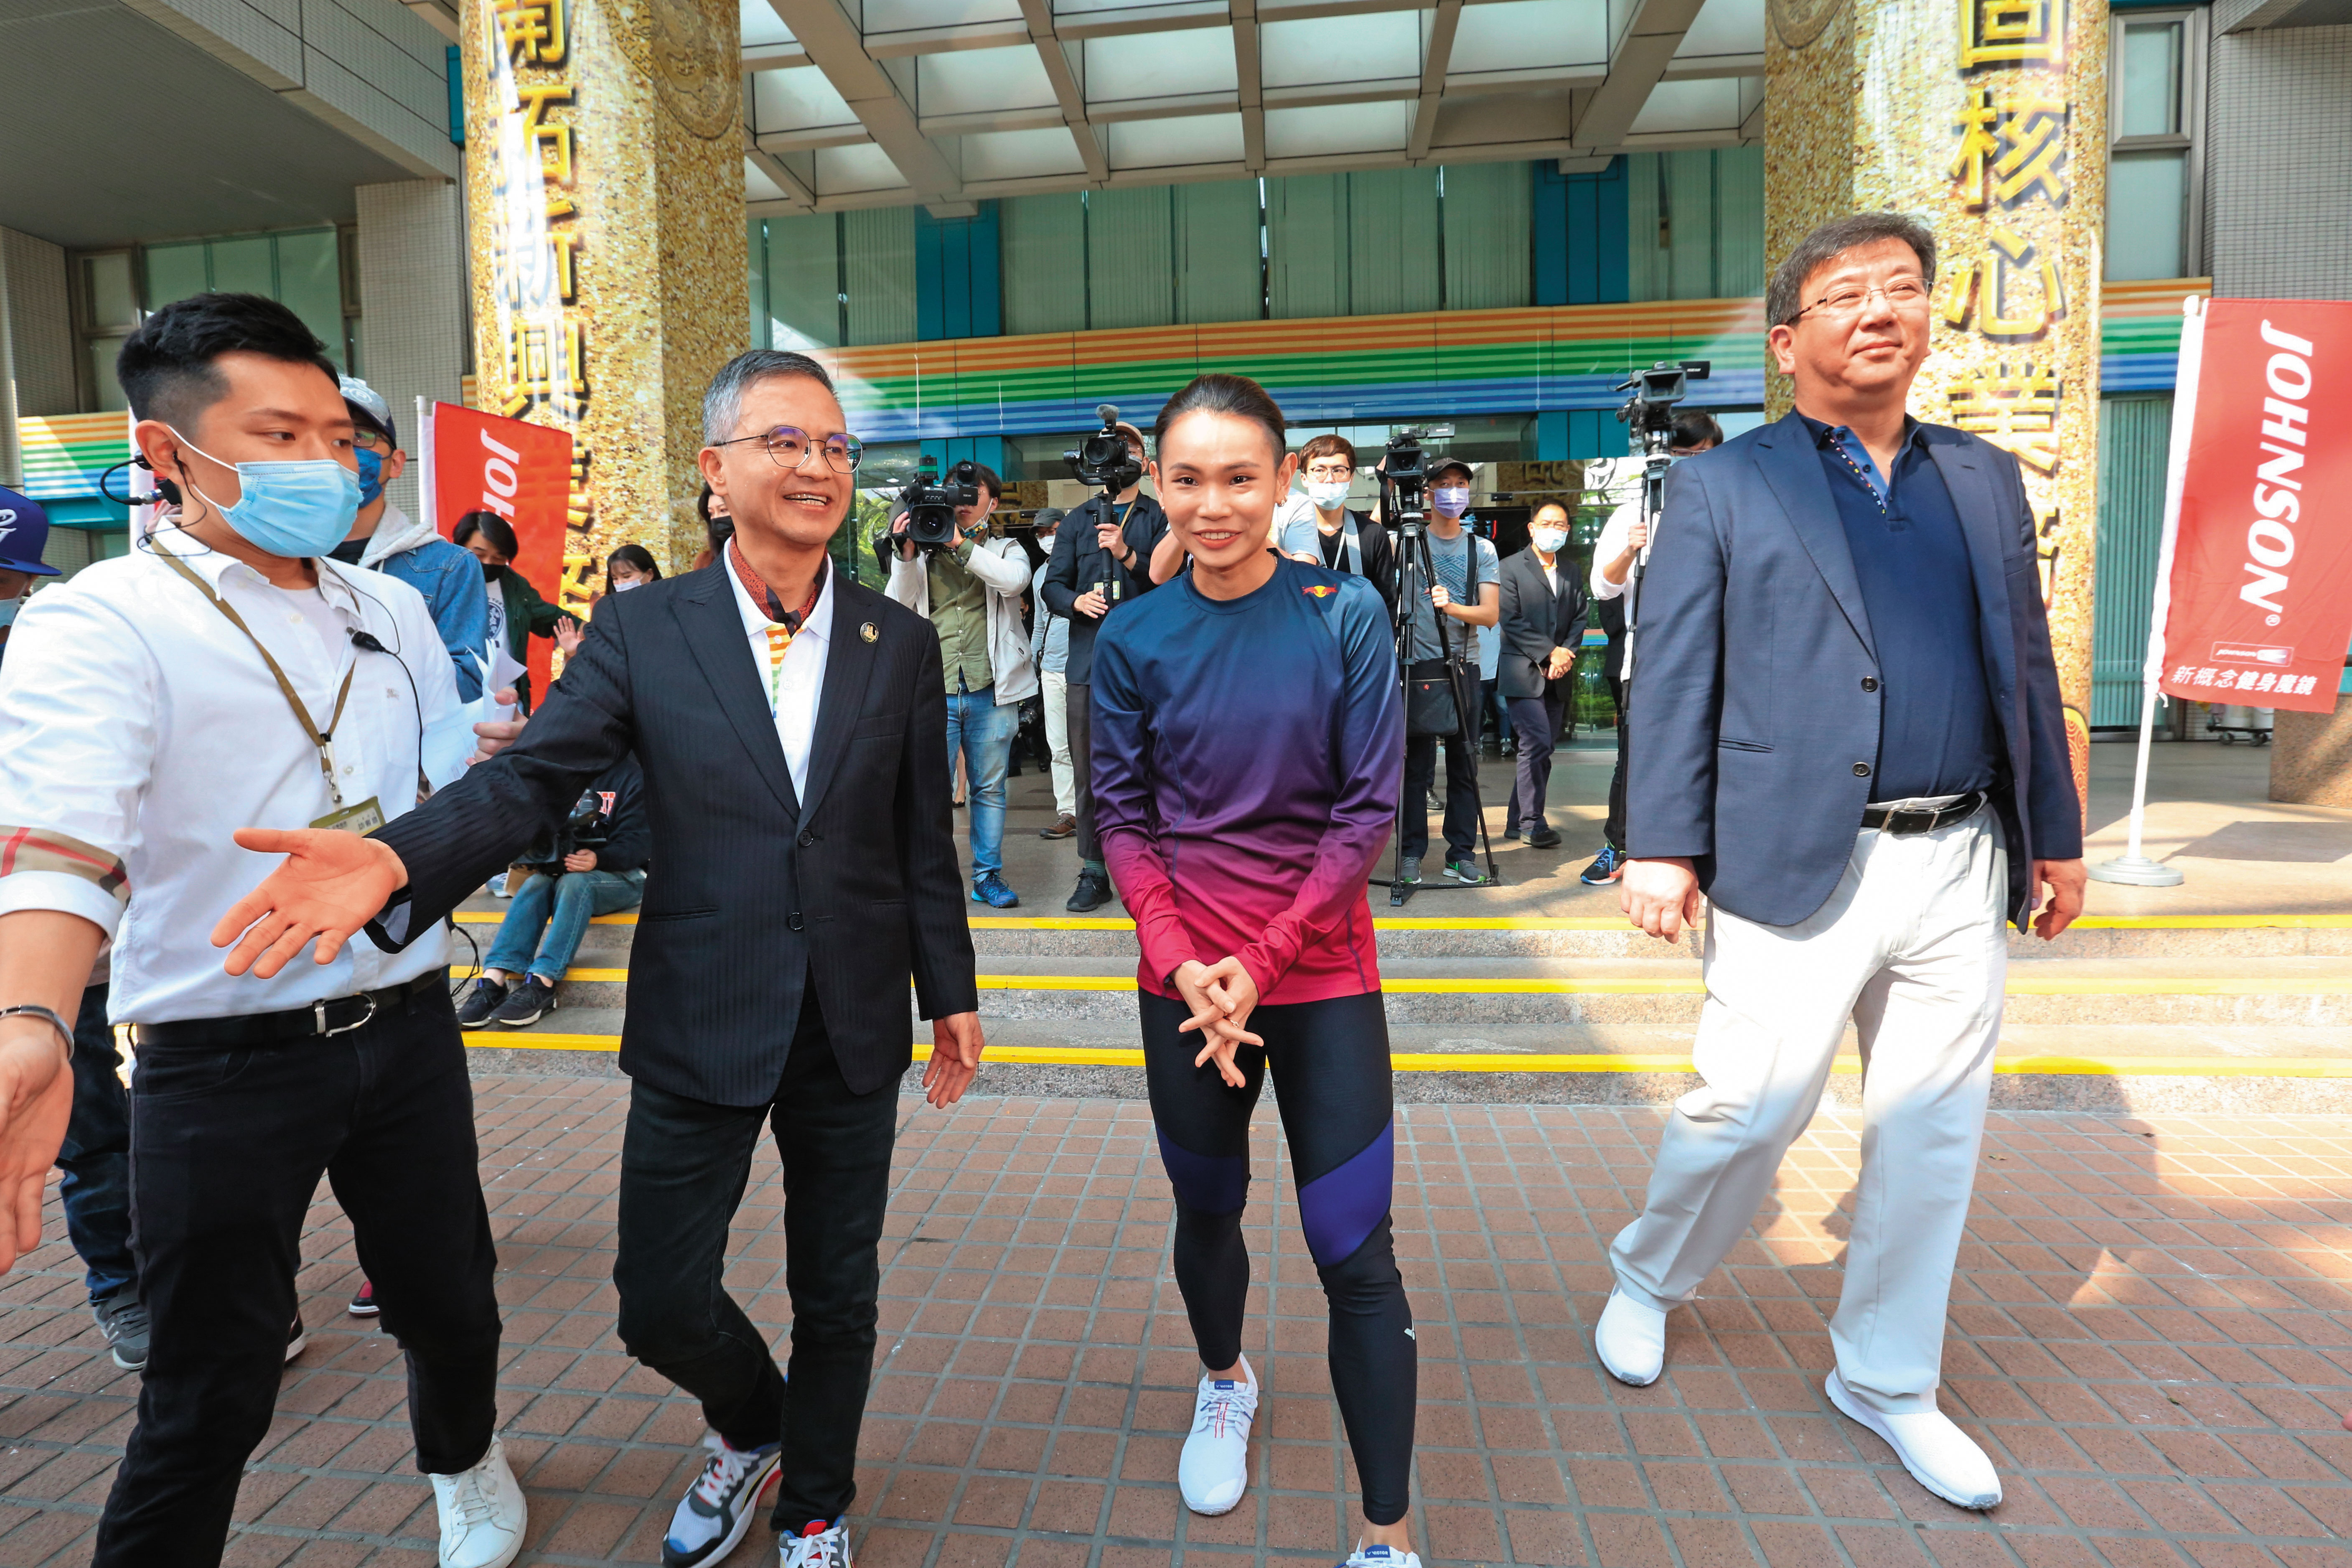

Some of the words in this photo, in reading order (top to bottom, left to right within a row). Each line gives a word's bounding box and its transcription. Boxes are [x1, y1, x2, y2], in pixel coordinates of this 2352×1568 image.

[1944, 0, 2065, 605] 固核心業
[2215, 649, 2257, 657] JOHNSON
[2171, 666, 2318, 695] 新概念健身魔鏡
